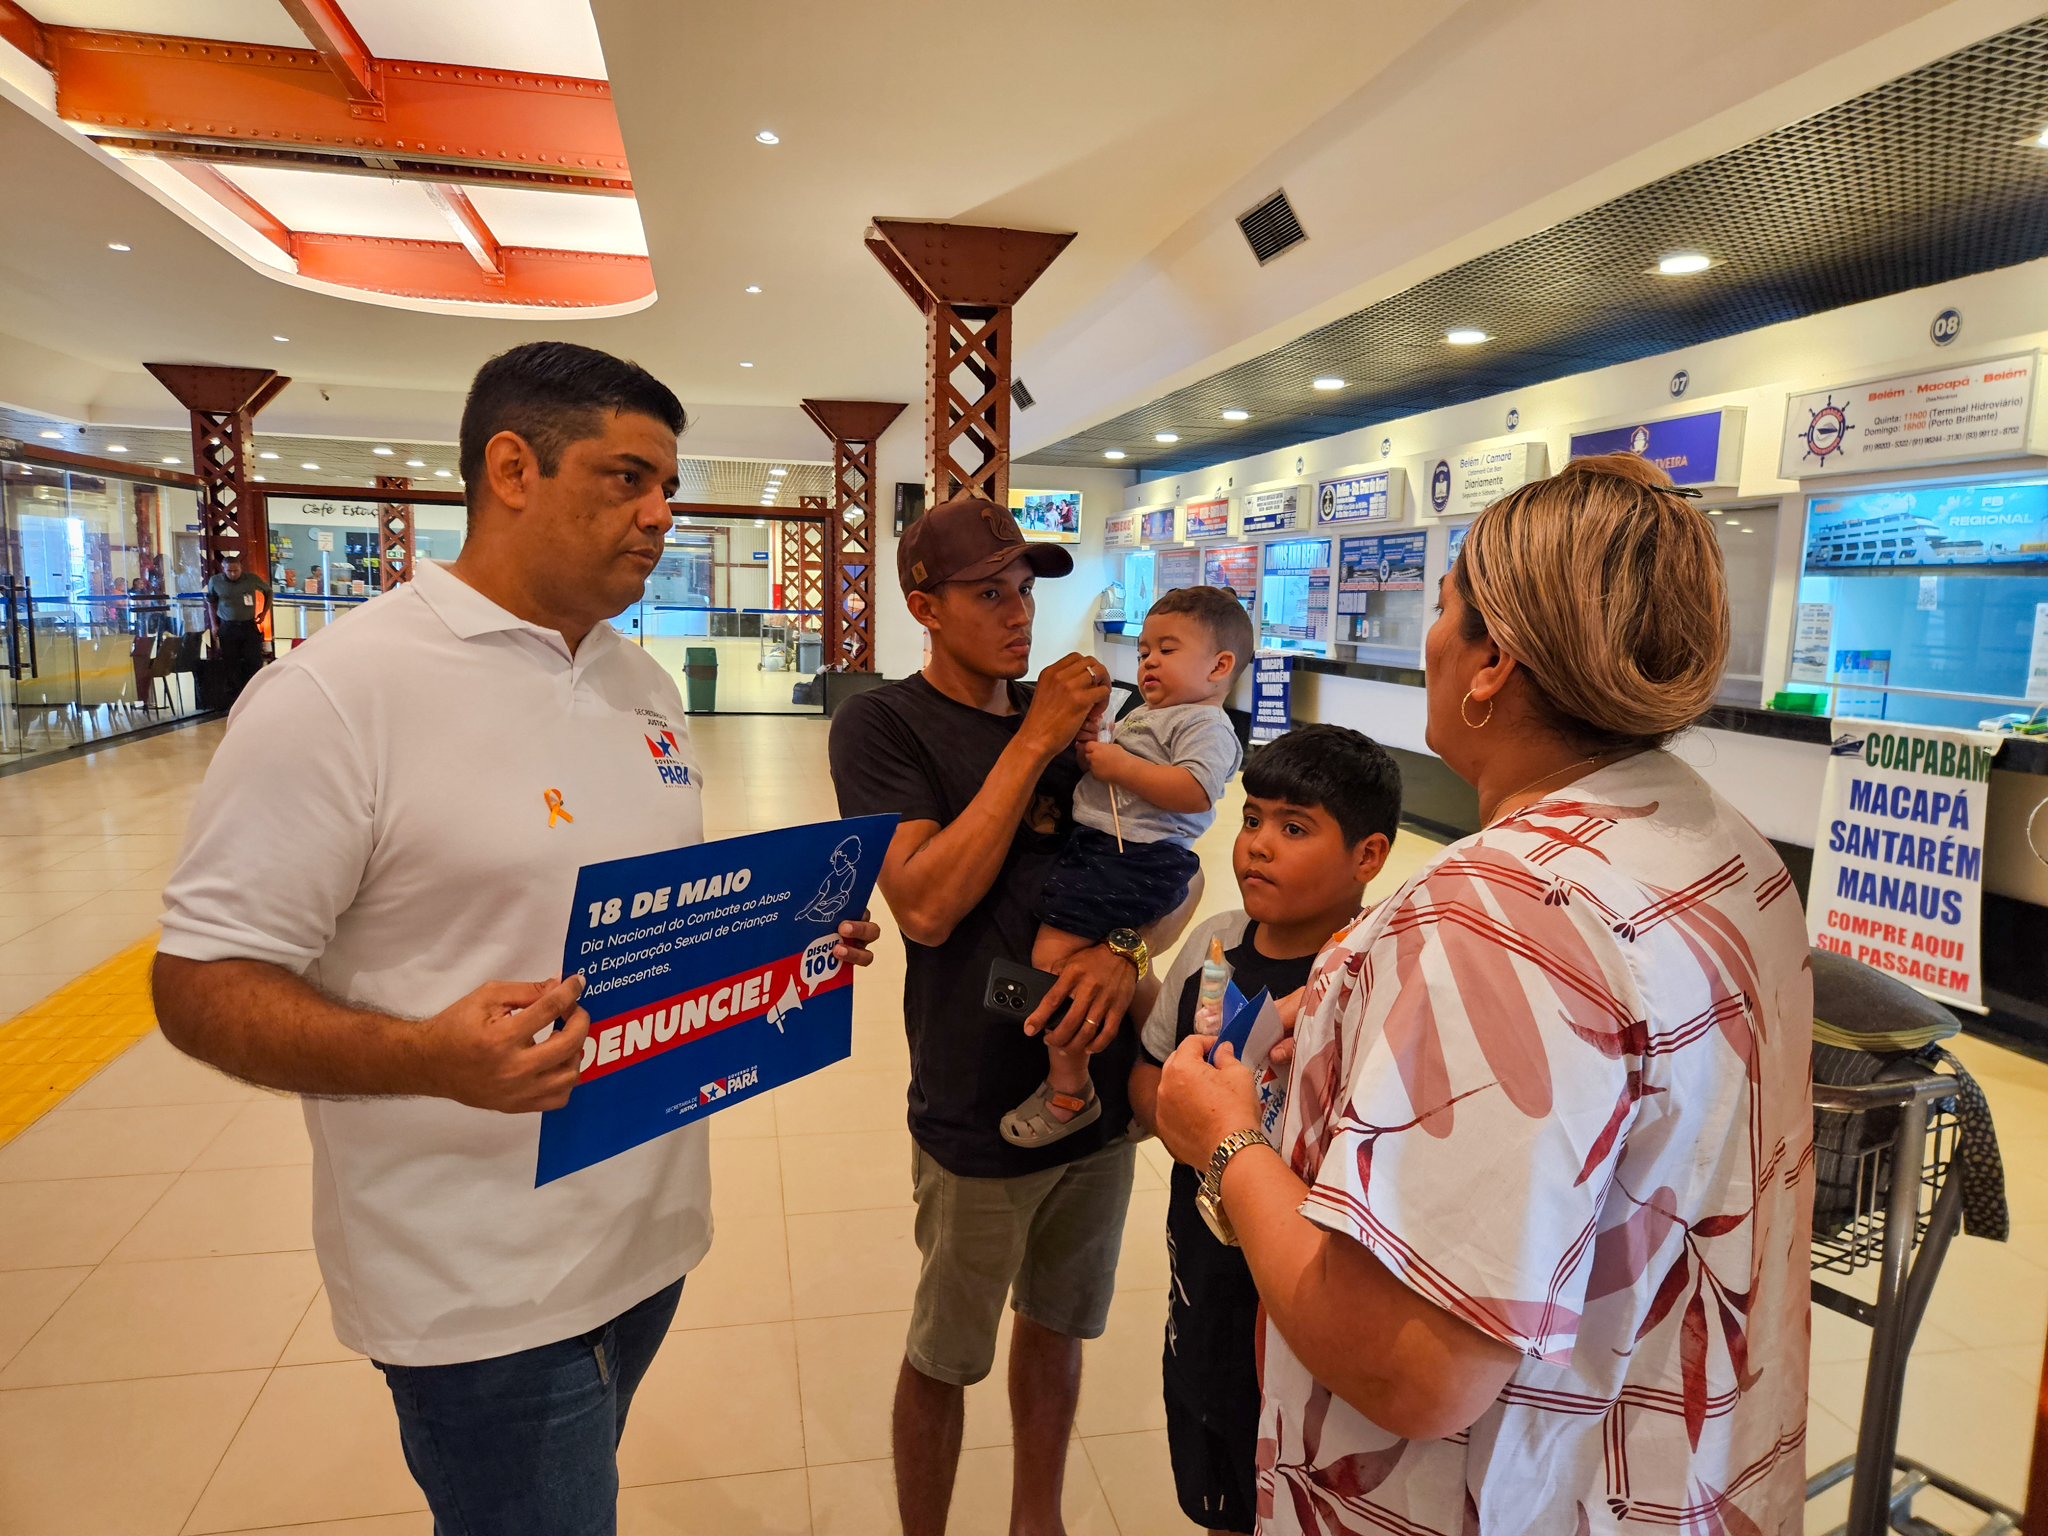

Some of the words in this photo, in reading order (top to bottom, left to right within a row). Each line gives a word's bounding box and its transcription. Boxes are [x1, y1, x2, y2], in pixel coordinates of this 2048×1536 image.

[1934, 316, 1959, 337] 08
[1670, 376, 1687, 392] 07
[1868, 386, 1905, 402] Belém
[1916, 375, 1970, 394] Macapá
[1983, 368, 2027, 383] Belém
[1507, 413, 1519, 427] 06
[1874, 414, 1901, 425] Quinta:
[1904, 410, 1927, 421] 11h00
[1929, 404, 1968, 419] (Terminal
[1971, 396, 2023, 412] Hidroviário)
[1864, 426, 1901, 437] Domingo:
[1928, 417, 1953, 430] (Porto
[1956, 411, 1998, 424] Brilhante)
[1460, 456, 1480, 469] Belém
[1486, 449, 1512, 464] Camará
[1464, 476, 1504, 490] Diariamente
[302, 503, 336, 517] Café
[1949, 513, 2034, 527] REGIONAL
[1256, 670, 1290, 683] SANTARÉM
[1258, 701, 1284, 709] COMPRE
[1850, 778, 1970, 831] MACAPÁ
[1829, 819, 1982, 882] SANTARÉM
[588, 897, 623, 929] 18
[630, 886, 672, 919] DE
[676, 868, 752, 908] MAIO
[1836, 866, 1963, 925] MANAUS
[580, 938, 605, 956] Dia
[607, 919, 667, 948] Nacional
[668, 917, 685, 932] do
[687, 903, 741, 926] Combate
[742, 900, 757, 912] ao
[757, 890, 791, 908] Abuso
[1827, 909, 1908, 946] COMPRE
[1910, 931, 1965, 962] AQUI
[577, 967, 586, 977] e
[588, 961, 598, 975] à
[601, 942, 672, 971] Exploração
[674, 927, 714, 950] Sexual
[714, 925, 730, 938] de
[731, 911, 779, 933] Crianças
[805, 952, 840, 978] 100
[1857, 944, 1970, 993] PASSAGEM
[584, 962, 672, 998] Adolescentes.
[579, 970, 773, 1074] DENUNCIE!
[727, 1067, 750, 1080] GOVERNO
[665, 1099, 691, 1114] SECRETARIA
[691, 1096, 698, 1104] DE
[678, 1103, 698, 1115] JUSTIÇA
